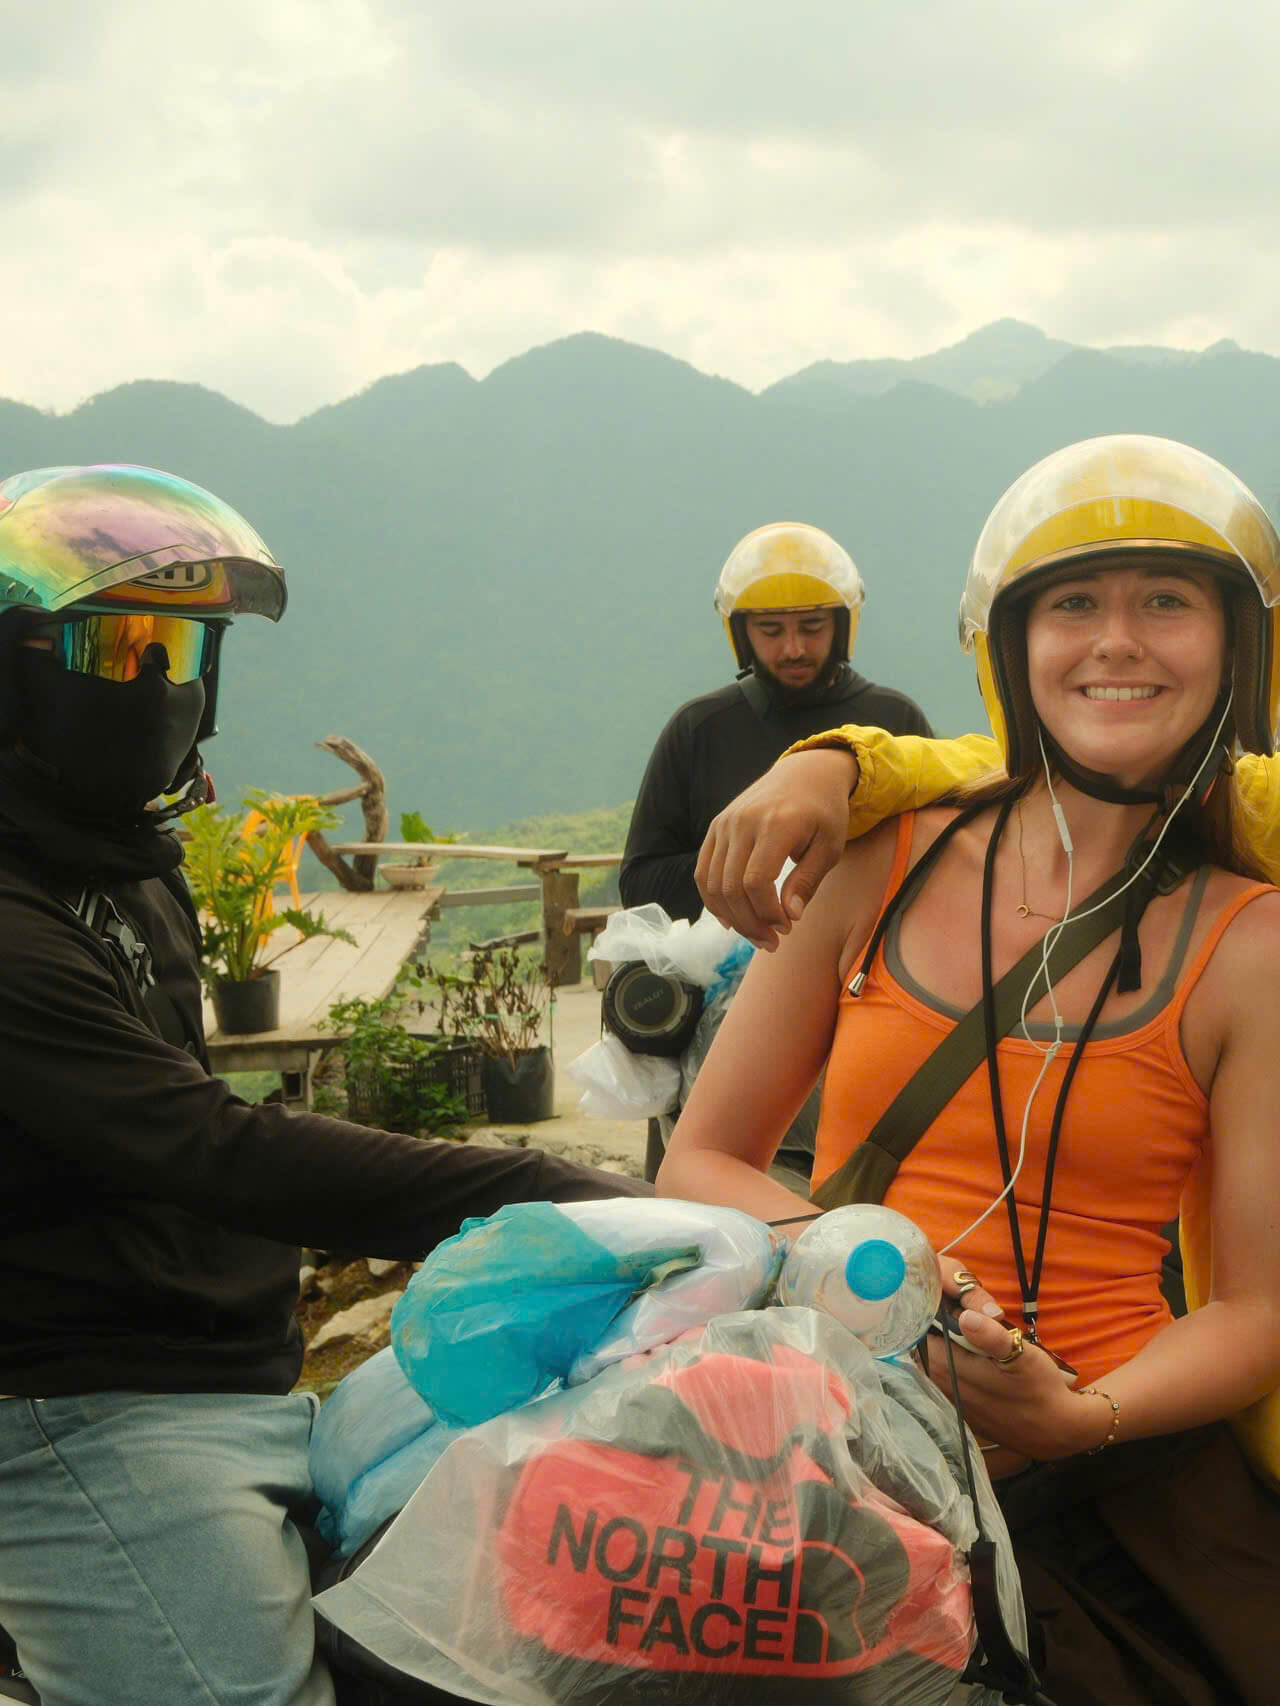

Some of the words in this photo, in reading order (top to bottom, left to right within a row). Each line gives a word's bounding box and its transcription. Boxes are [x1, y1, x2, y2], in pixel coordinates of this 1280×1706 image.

[678, 1462, 796, 1547] THE
[546, 1503, 796, 1609] NORTH
[606, 1585, 789, 1661] FACE
